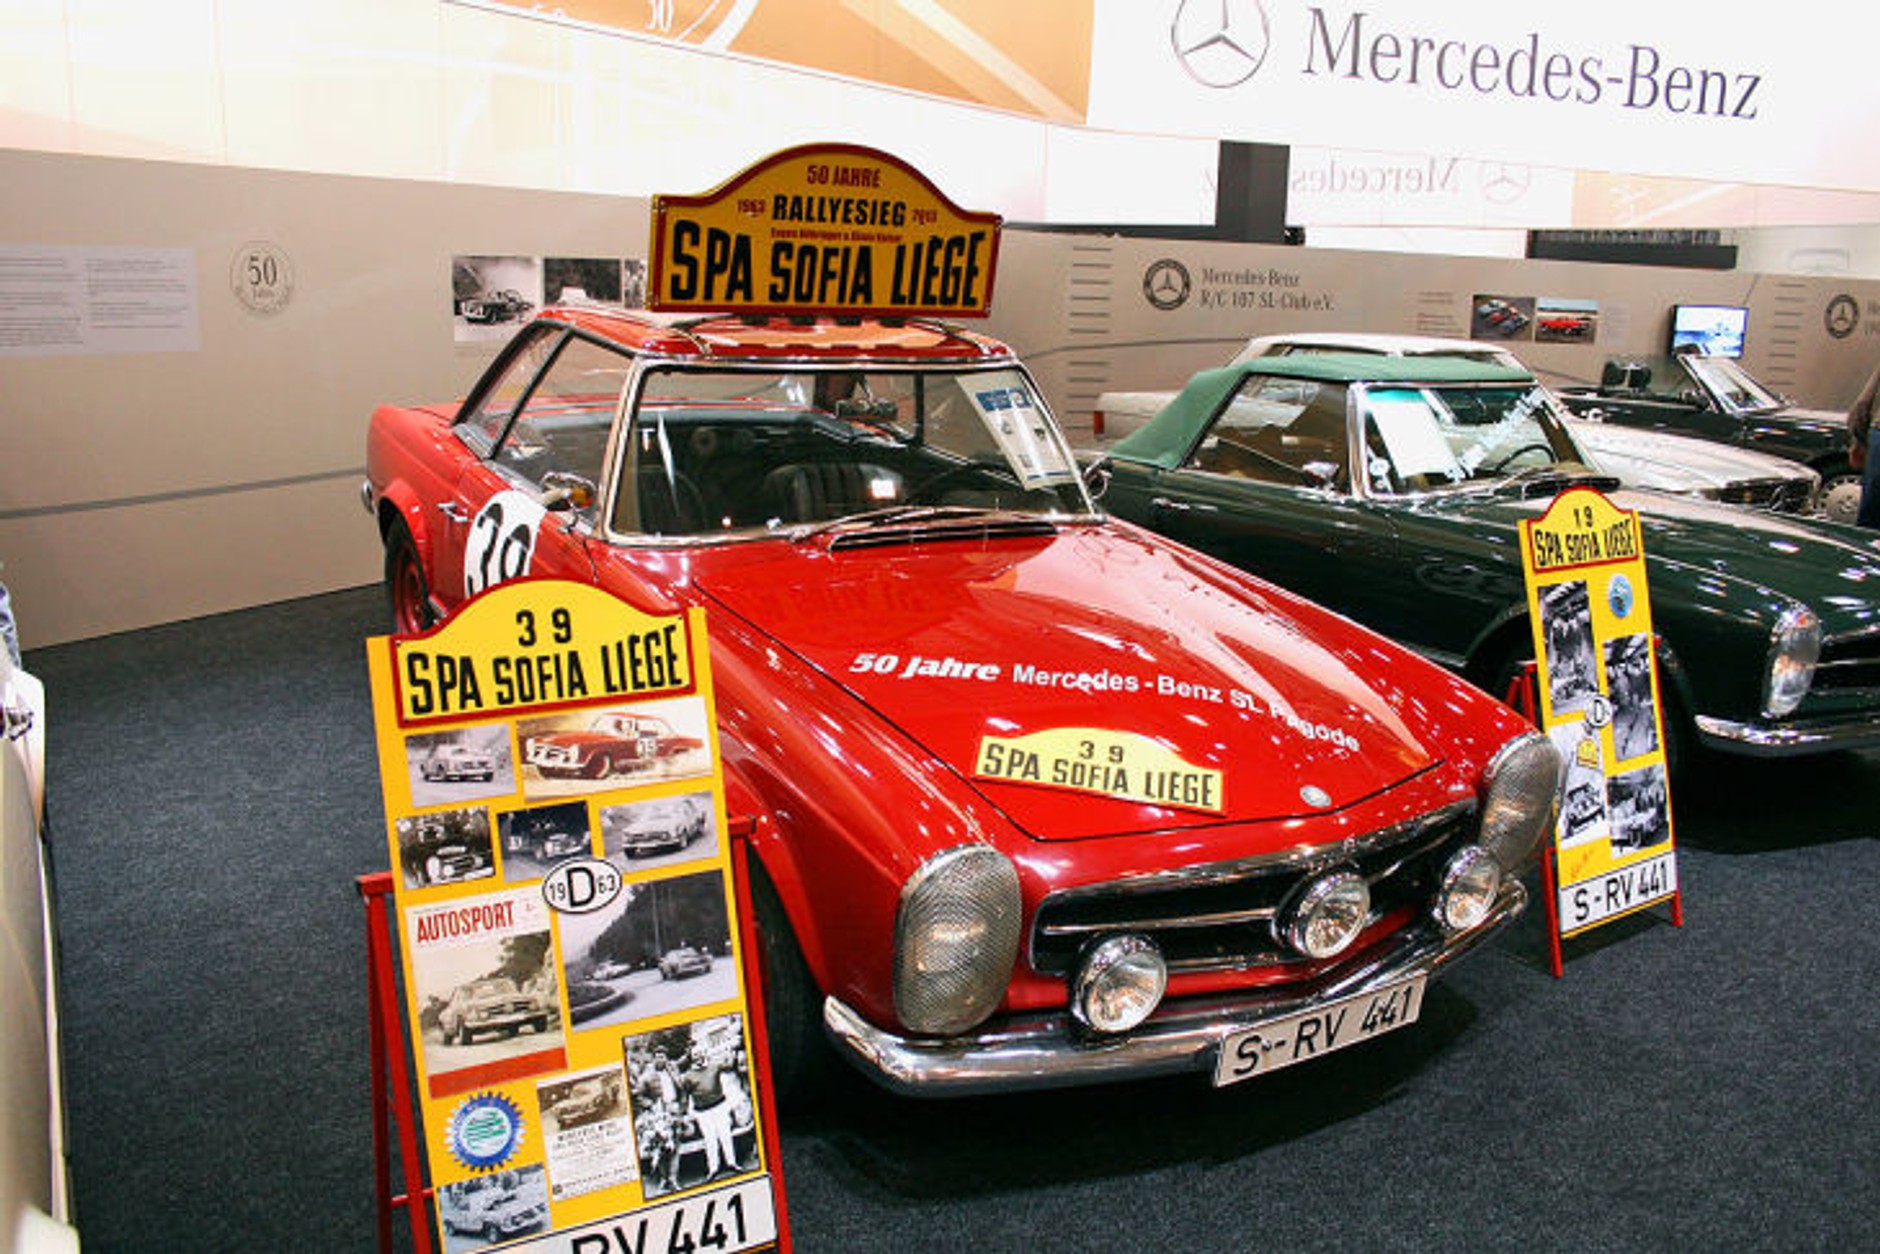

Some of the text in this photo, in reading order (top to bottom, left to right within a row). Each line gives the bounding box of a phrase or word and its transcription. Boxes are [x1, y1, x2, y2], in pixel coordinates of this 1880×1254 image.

[1301, 7, 1763, 120] Mercedes-Benz
[807, 165, 880, 188] 50 JAHRE
[772, 194, 907, 227] RALLYESIEG
[248, 255, 278, 287] 50
[670, 219, 755, 302] SPA
[768, 241, 874, 304] SOFIA
[1202, 268, 1301, 288] Mercedes-Benz
[1232, 291, 1256, 308] 107
[1534, 529, 1564, 566] SPA
[1565, 531, 1600, 562] SOFIA
[406, 624, 683, 715] SPA SOFIA LIEGE
[849, 653, 899, 674] 50
[900, 656, 1001, 682] Jahre
[1230, 688, 1264, 714] SL
[983, 743, 1040, 780] SPA
[1052, 758, 1129, 793] SOFIA
[549, 867, 615, 908] 19 D 63
[1638, 861, 1668, 897] 441
[417, 900, 515, 943] AUTOSPORT
[1360, 986, 1413, 1033] 441
[667, 1192, 747, 1254] 441
